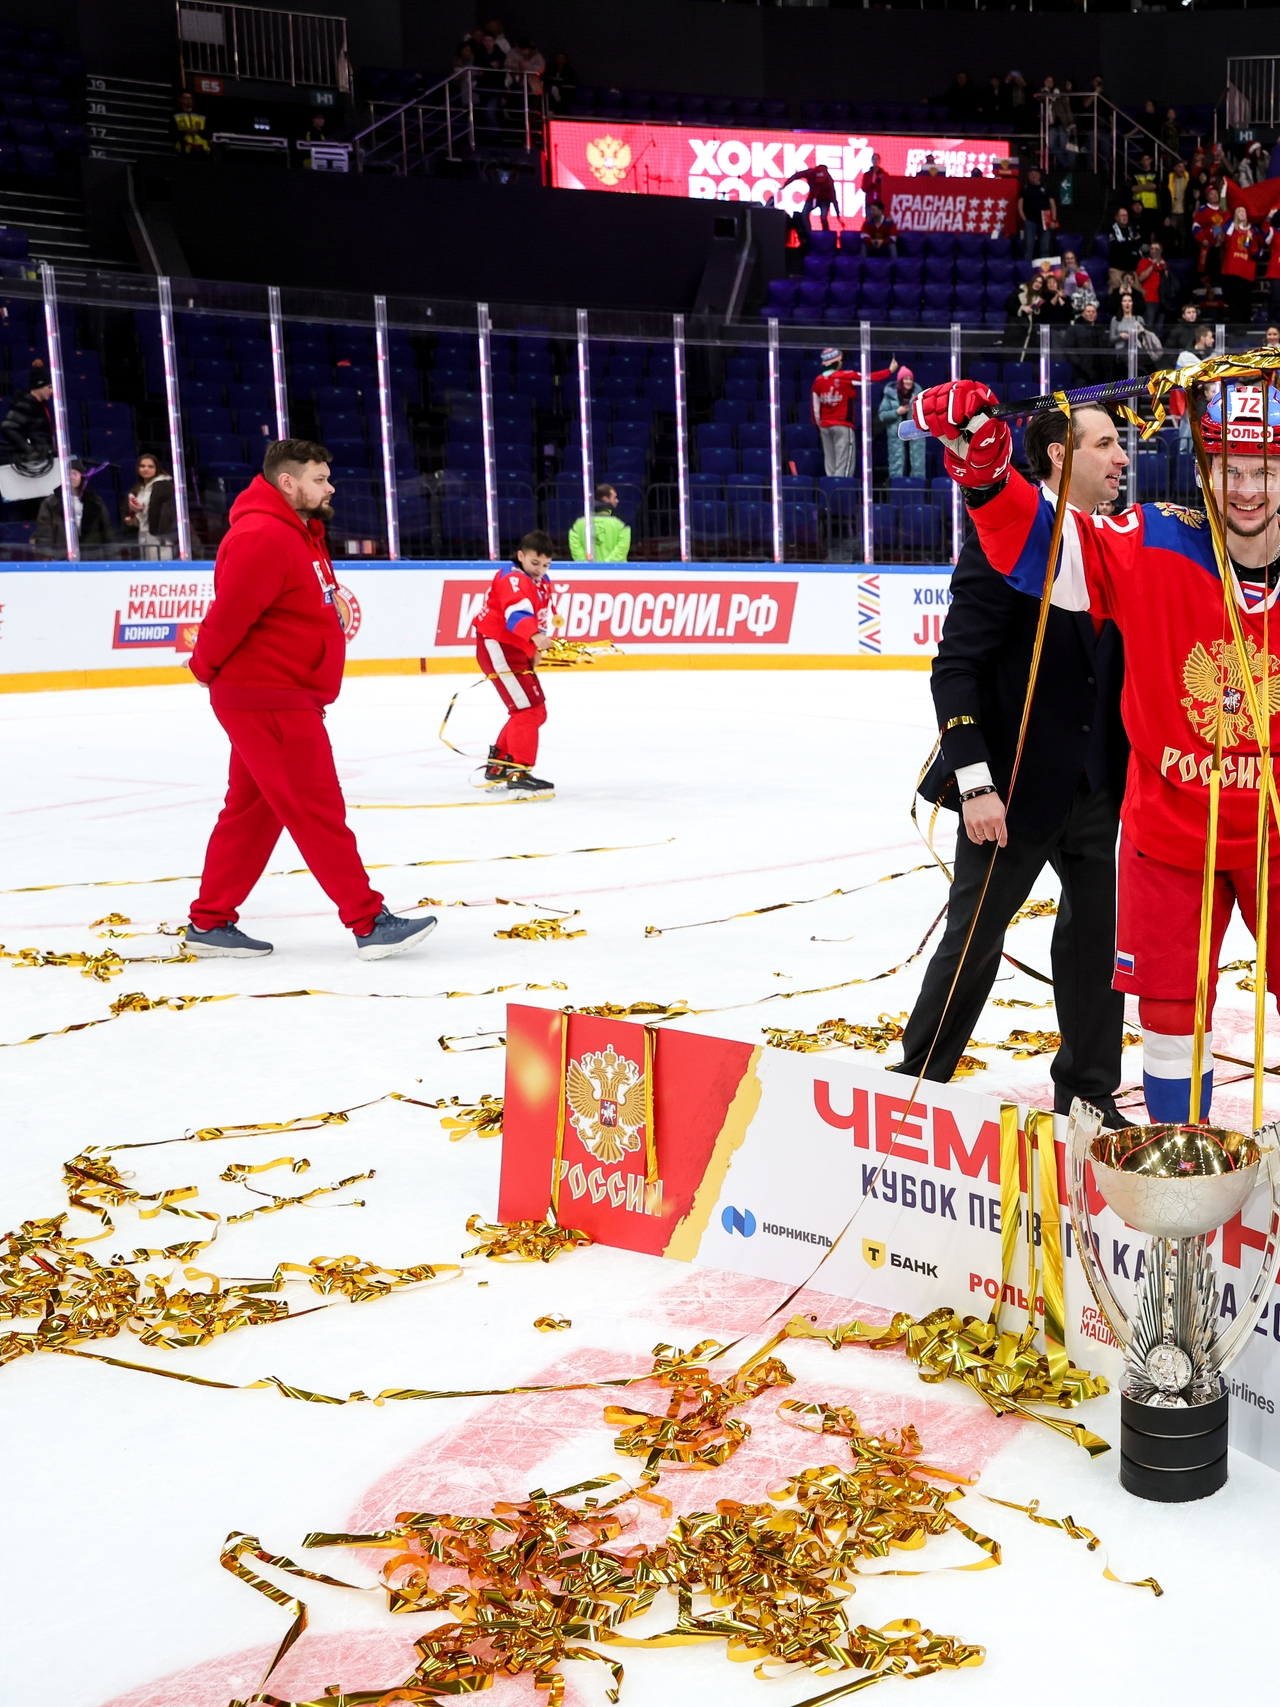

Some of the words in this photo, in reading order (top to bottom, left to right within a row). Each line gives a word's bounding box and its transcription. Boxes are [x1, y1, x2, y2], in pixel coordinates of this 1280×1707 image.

[201, 77, 220, 93] E5
[316, 93, 333, 105] H1
[1239, 130, 1253, 141] H1
[688, 137, 874, 180] ХОККЕЙ
[891, 194, 967, 213] КРАСНАЯ
[1237, 397, 1261, 413] 72
[129, 583, 198, 598] КРАСНАЯ
[913, 588, 954, 605] ХОКК
[457, 583, 779, 637] ИЙВРОССИИ.РФ
[124, 625, 170, 642] ЮНИОР
[861, 1163, 958, 1222] КУБОК
[762, 1221, 833, 1248] НОРНИКЕЛЬ
[890, 1253, 938, 1279] БАНК
[1080, 1319, 1120, 1349] МАШИ
